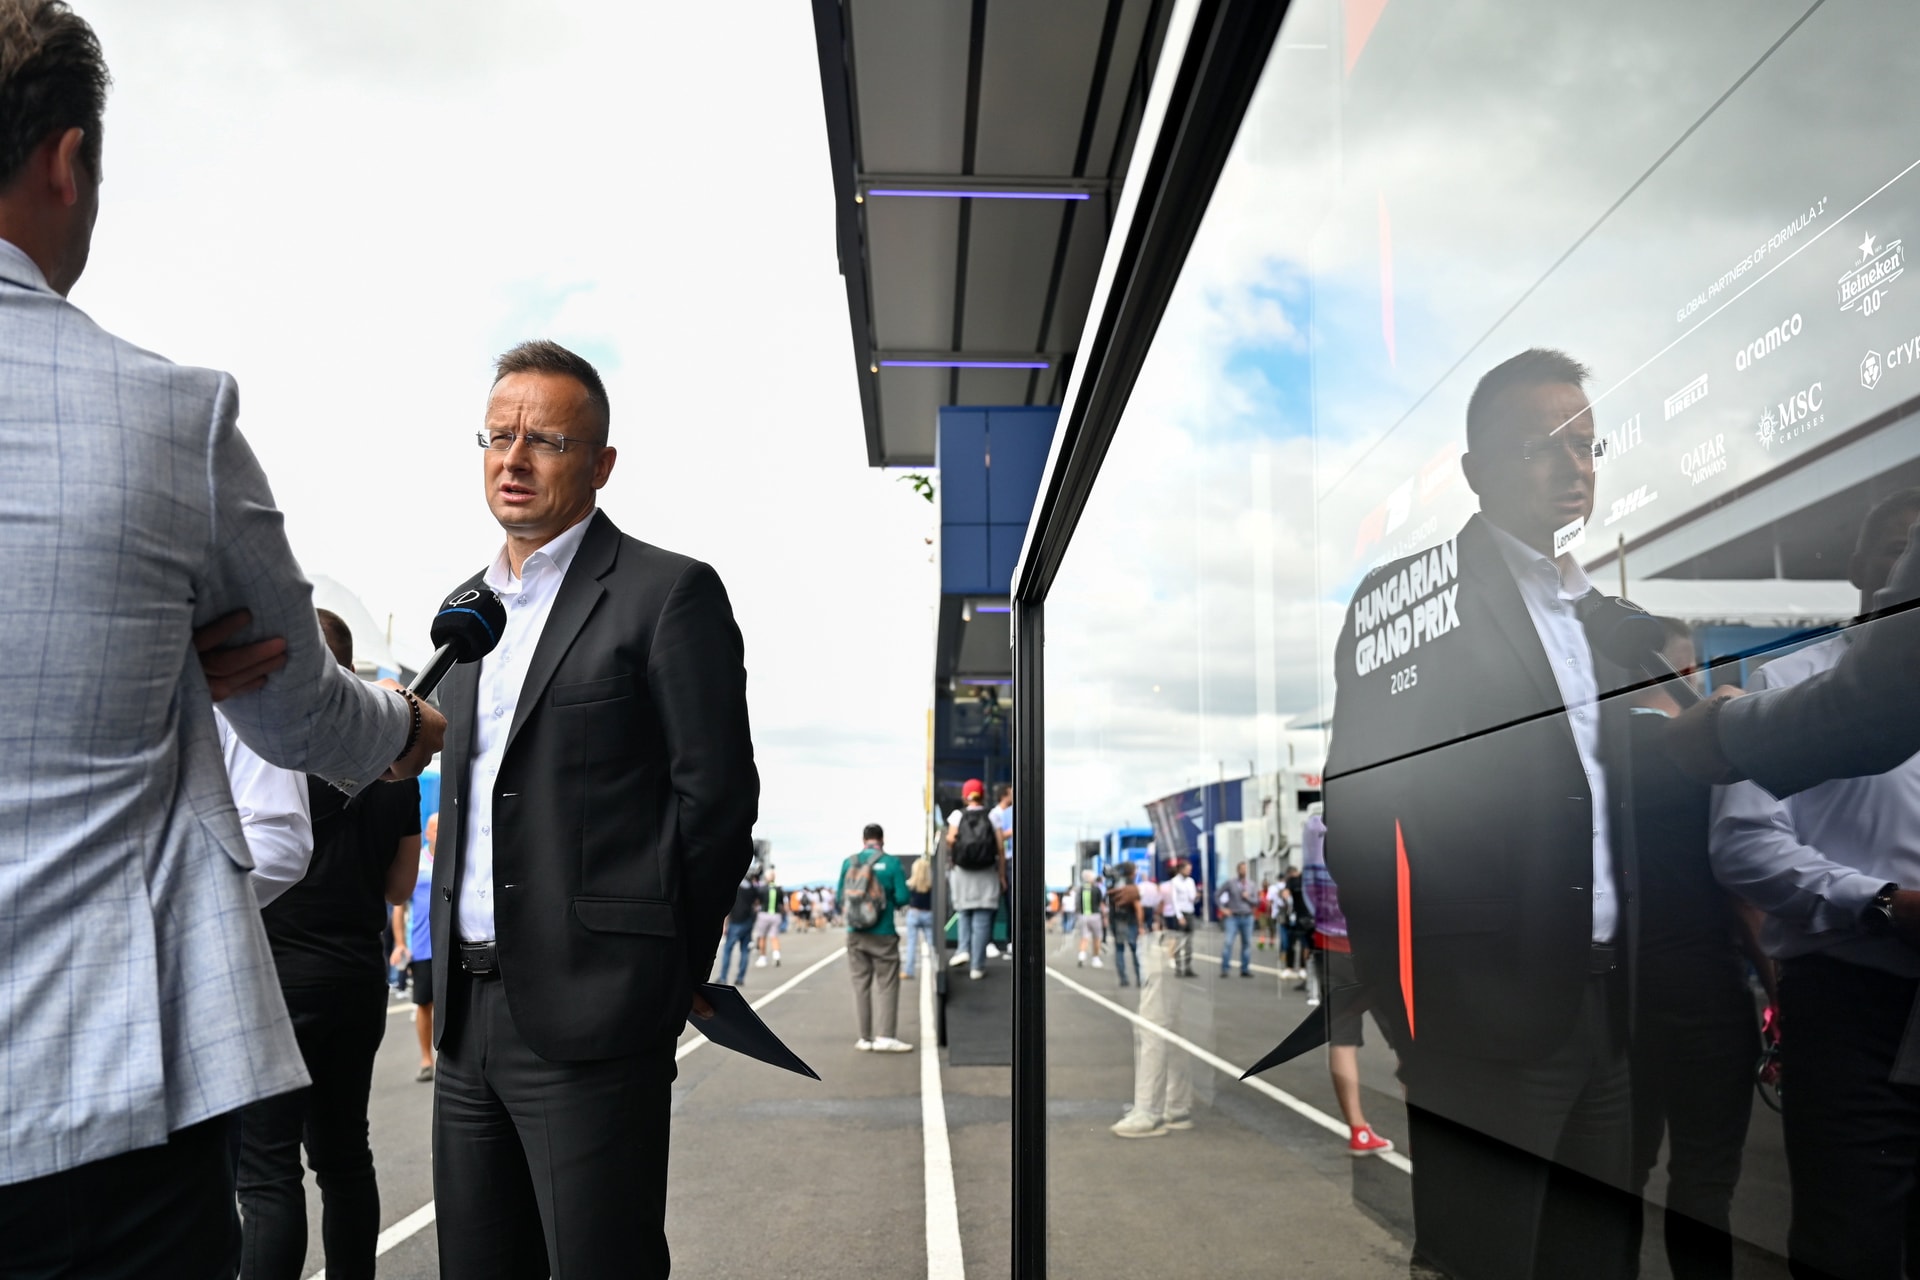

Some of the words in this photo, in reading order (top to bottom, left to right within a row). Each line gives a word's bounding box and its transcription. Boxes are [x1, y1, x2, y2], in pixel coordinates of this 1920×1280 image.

[1676, 292, 1708, 322] GLOBAL
[1708, 255, 1753, 299] PARTNERS
[1754, 243, 1767, 263] OF
[1768, 207, 1816, 253] FORMULA
[1736, 313, 1802, 372] aramco
[1664, 373, 1708, 421] PIRELLI
[1778, 382, 1823, 431] MSC
[1780, 415, 1824, 444] CRUISES
[1681, 433, 1725, 477] QATAR
[1692, 456, 1727, 486] AIRWAYS
[1605, 484, 1656, 525] DHL
[1556, 526, 1583, 550] Lenovo
[1355, 536, 1458, 638] HUNGARIAN
[1356, 613, 1412, 677] GRAND
[1413, 583, 1460, 648] PRIX
[1391, 664, 1418, 695] 2025
